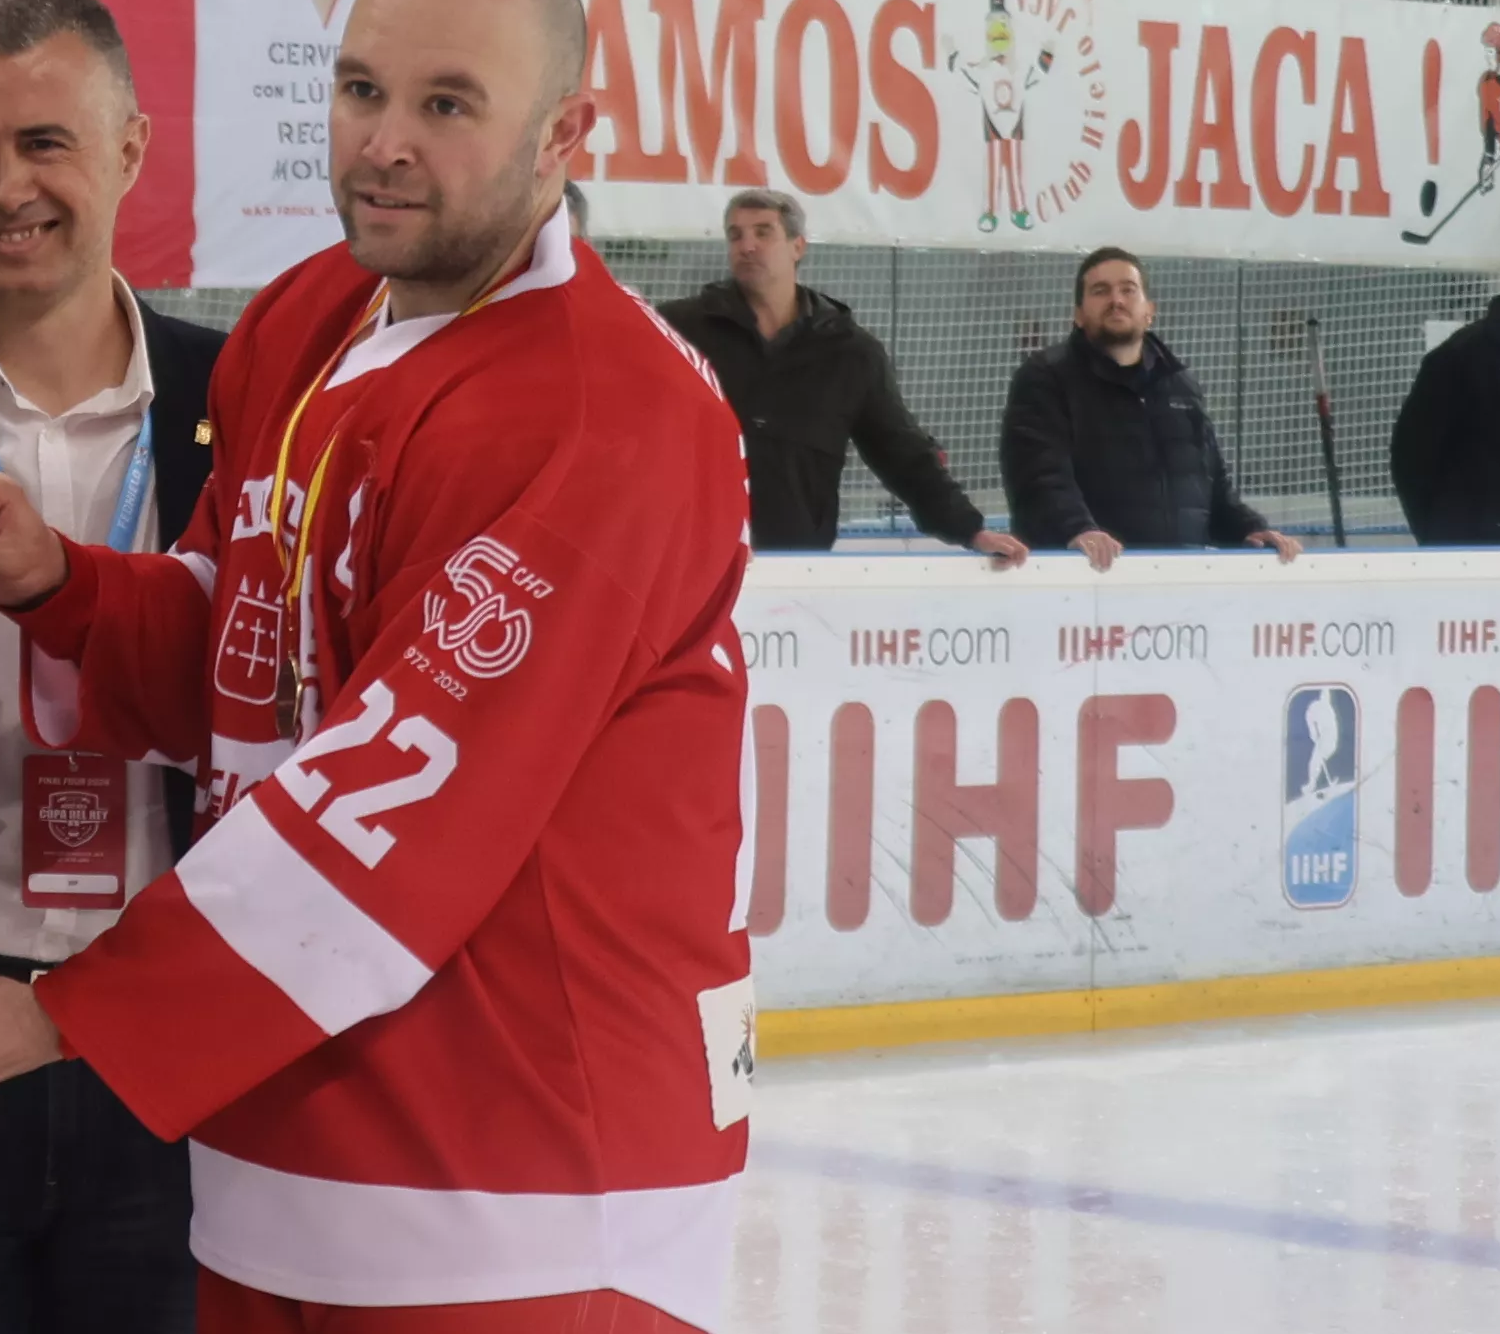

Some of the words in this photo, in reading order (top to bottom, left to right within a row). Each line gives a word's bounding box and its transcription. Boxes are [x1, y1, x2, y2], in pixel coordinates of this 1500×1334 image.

[1036, 160, 1092, 223] Club
[1078, 35, 1106, 150] Hielo
[1116, 20, 1391, 217] JACA
[850, 626, 1010, 667] IIHF.com
[1058, 623, 1208, 663] IIHF.com
[1252, 620, 1395, 657] IIHF.com
[274, 679, 458, 870] 22
[750, 692, 1177, 938] IIHF
[1292, 852, 1347, 884] IIHF
